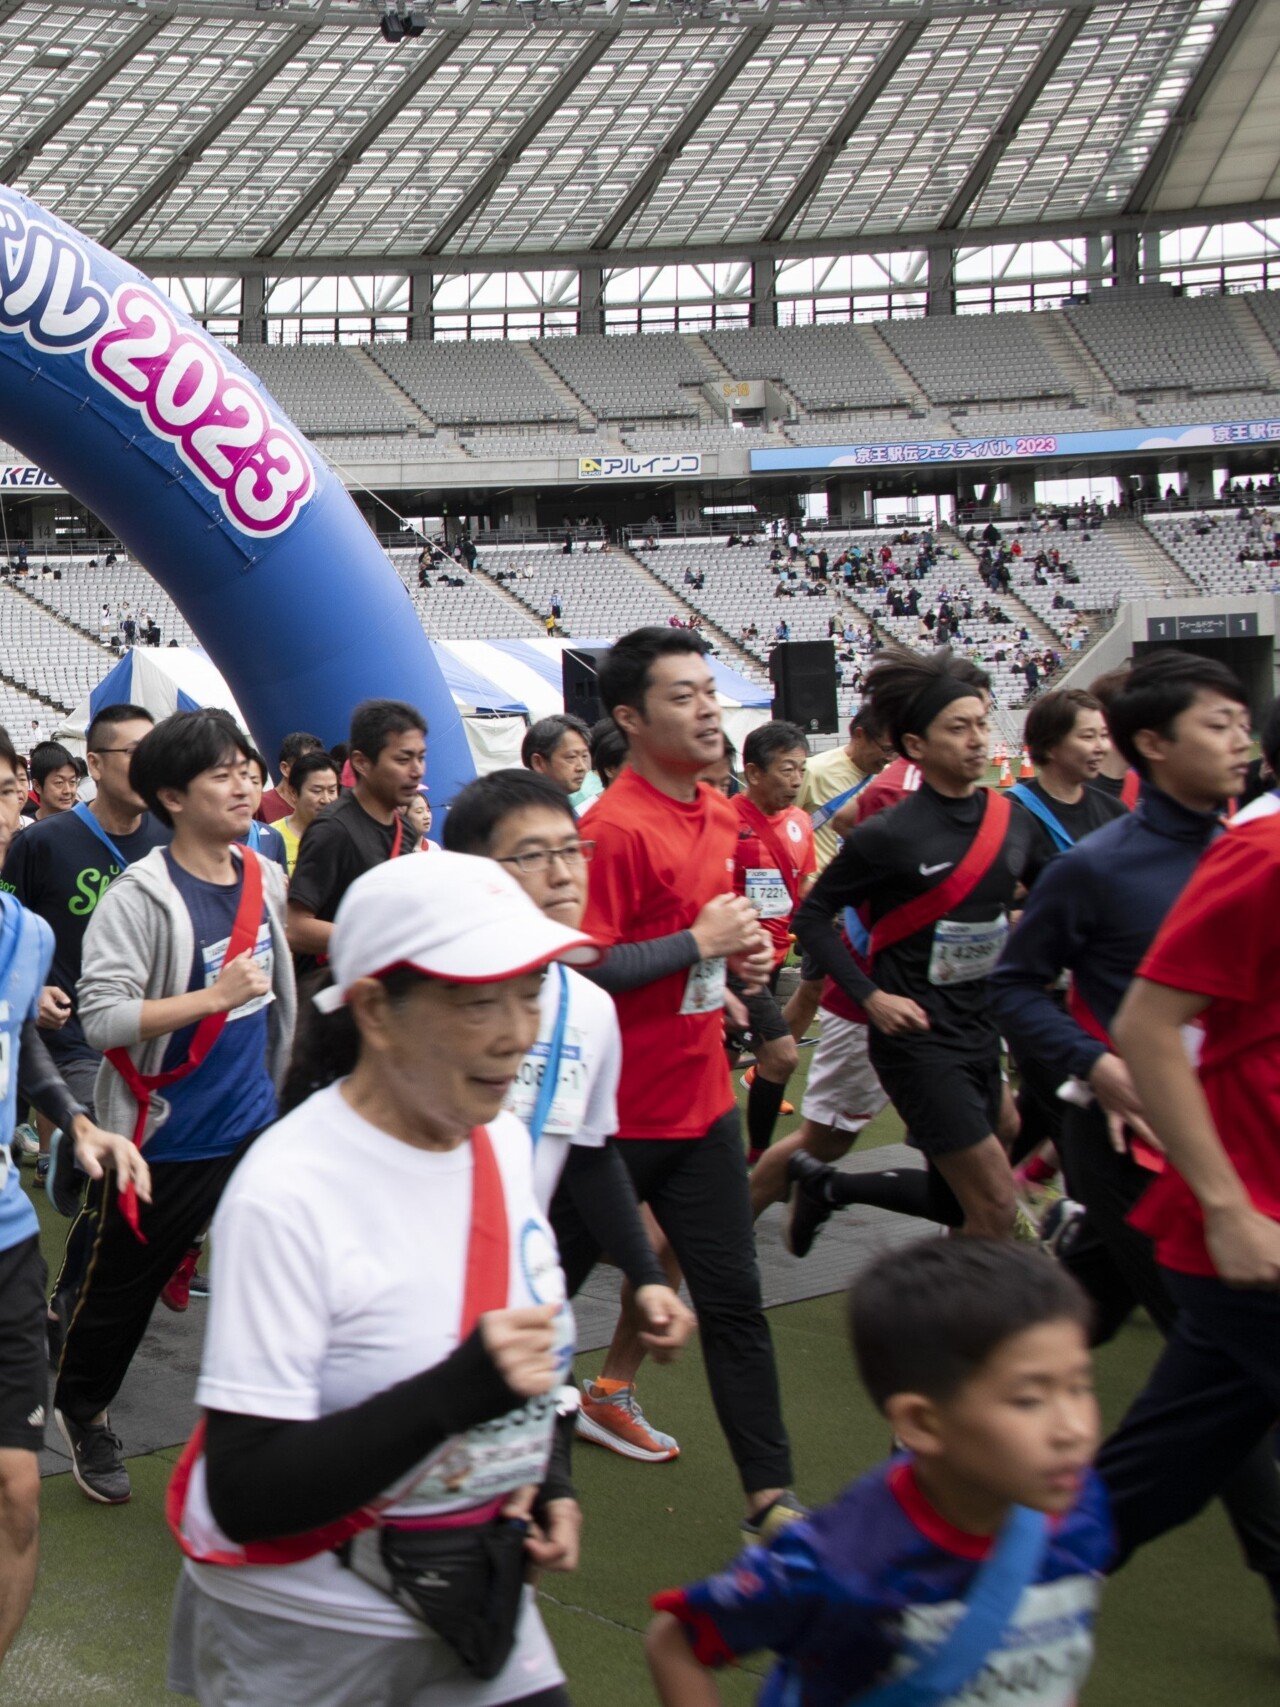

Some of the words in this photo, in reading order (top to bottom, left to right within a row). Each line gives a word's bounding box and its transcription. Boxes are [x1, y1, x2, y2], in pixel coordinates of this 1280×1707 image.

[86, 282, 318, 538] 2023
[855, 440, 1011, 464] 京王駅伝フェスティバル
[1016, 436, 1057, 454] 2023
[604, 456, 699, 475] アルインコ
[849, 500, 857, 513] 9
[679, 508, 695, 521] 10
[38, 525, 51, 538] 14
[1157, 622, 1166, 635] 1
[1239, 618, 1247, 631] 1
